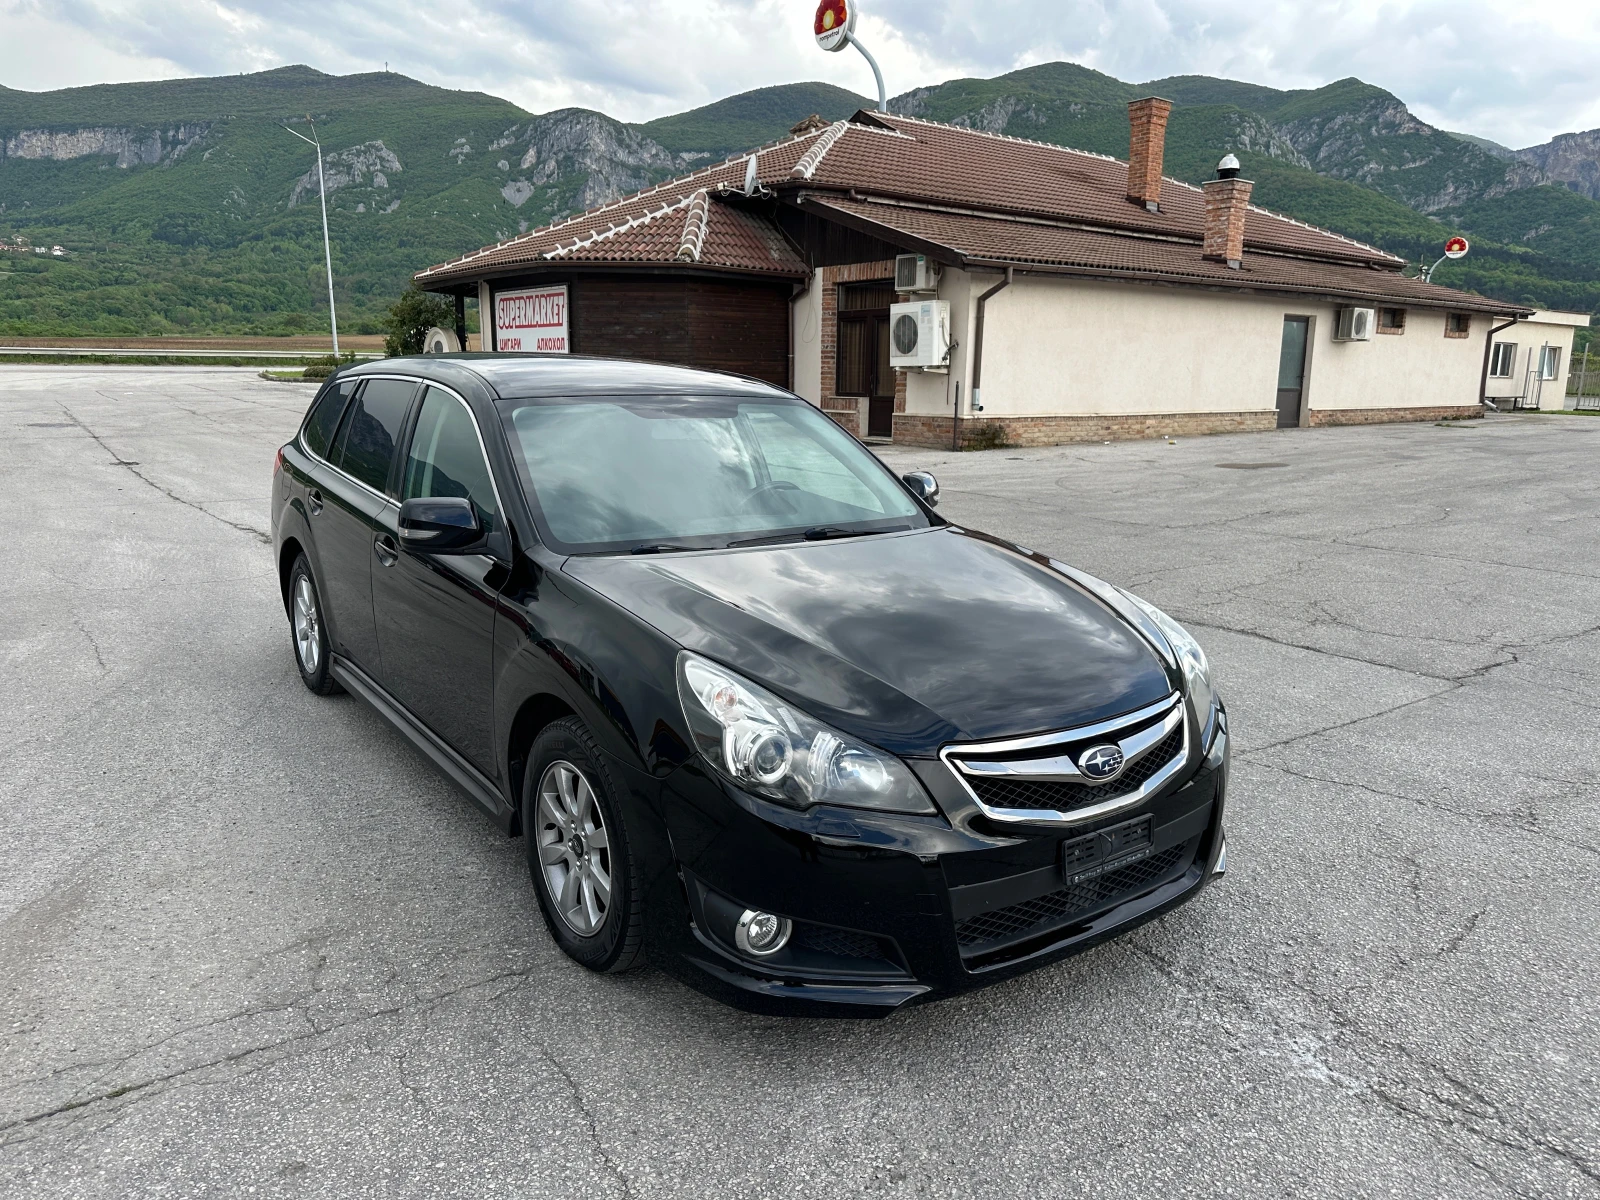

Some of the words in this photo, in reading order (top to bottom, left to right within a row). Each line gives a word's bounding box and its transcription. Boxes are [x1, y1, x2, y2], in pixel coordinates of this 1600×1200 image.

[499, 293, 564, 329] SUPERMARKET
[500, 338, 521, 351] ЦИГАРИ
[537, 337, 565, 351] АЛКОХОЛ
